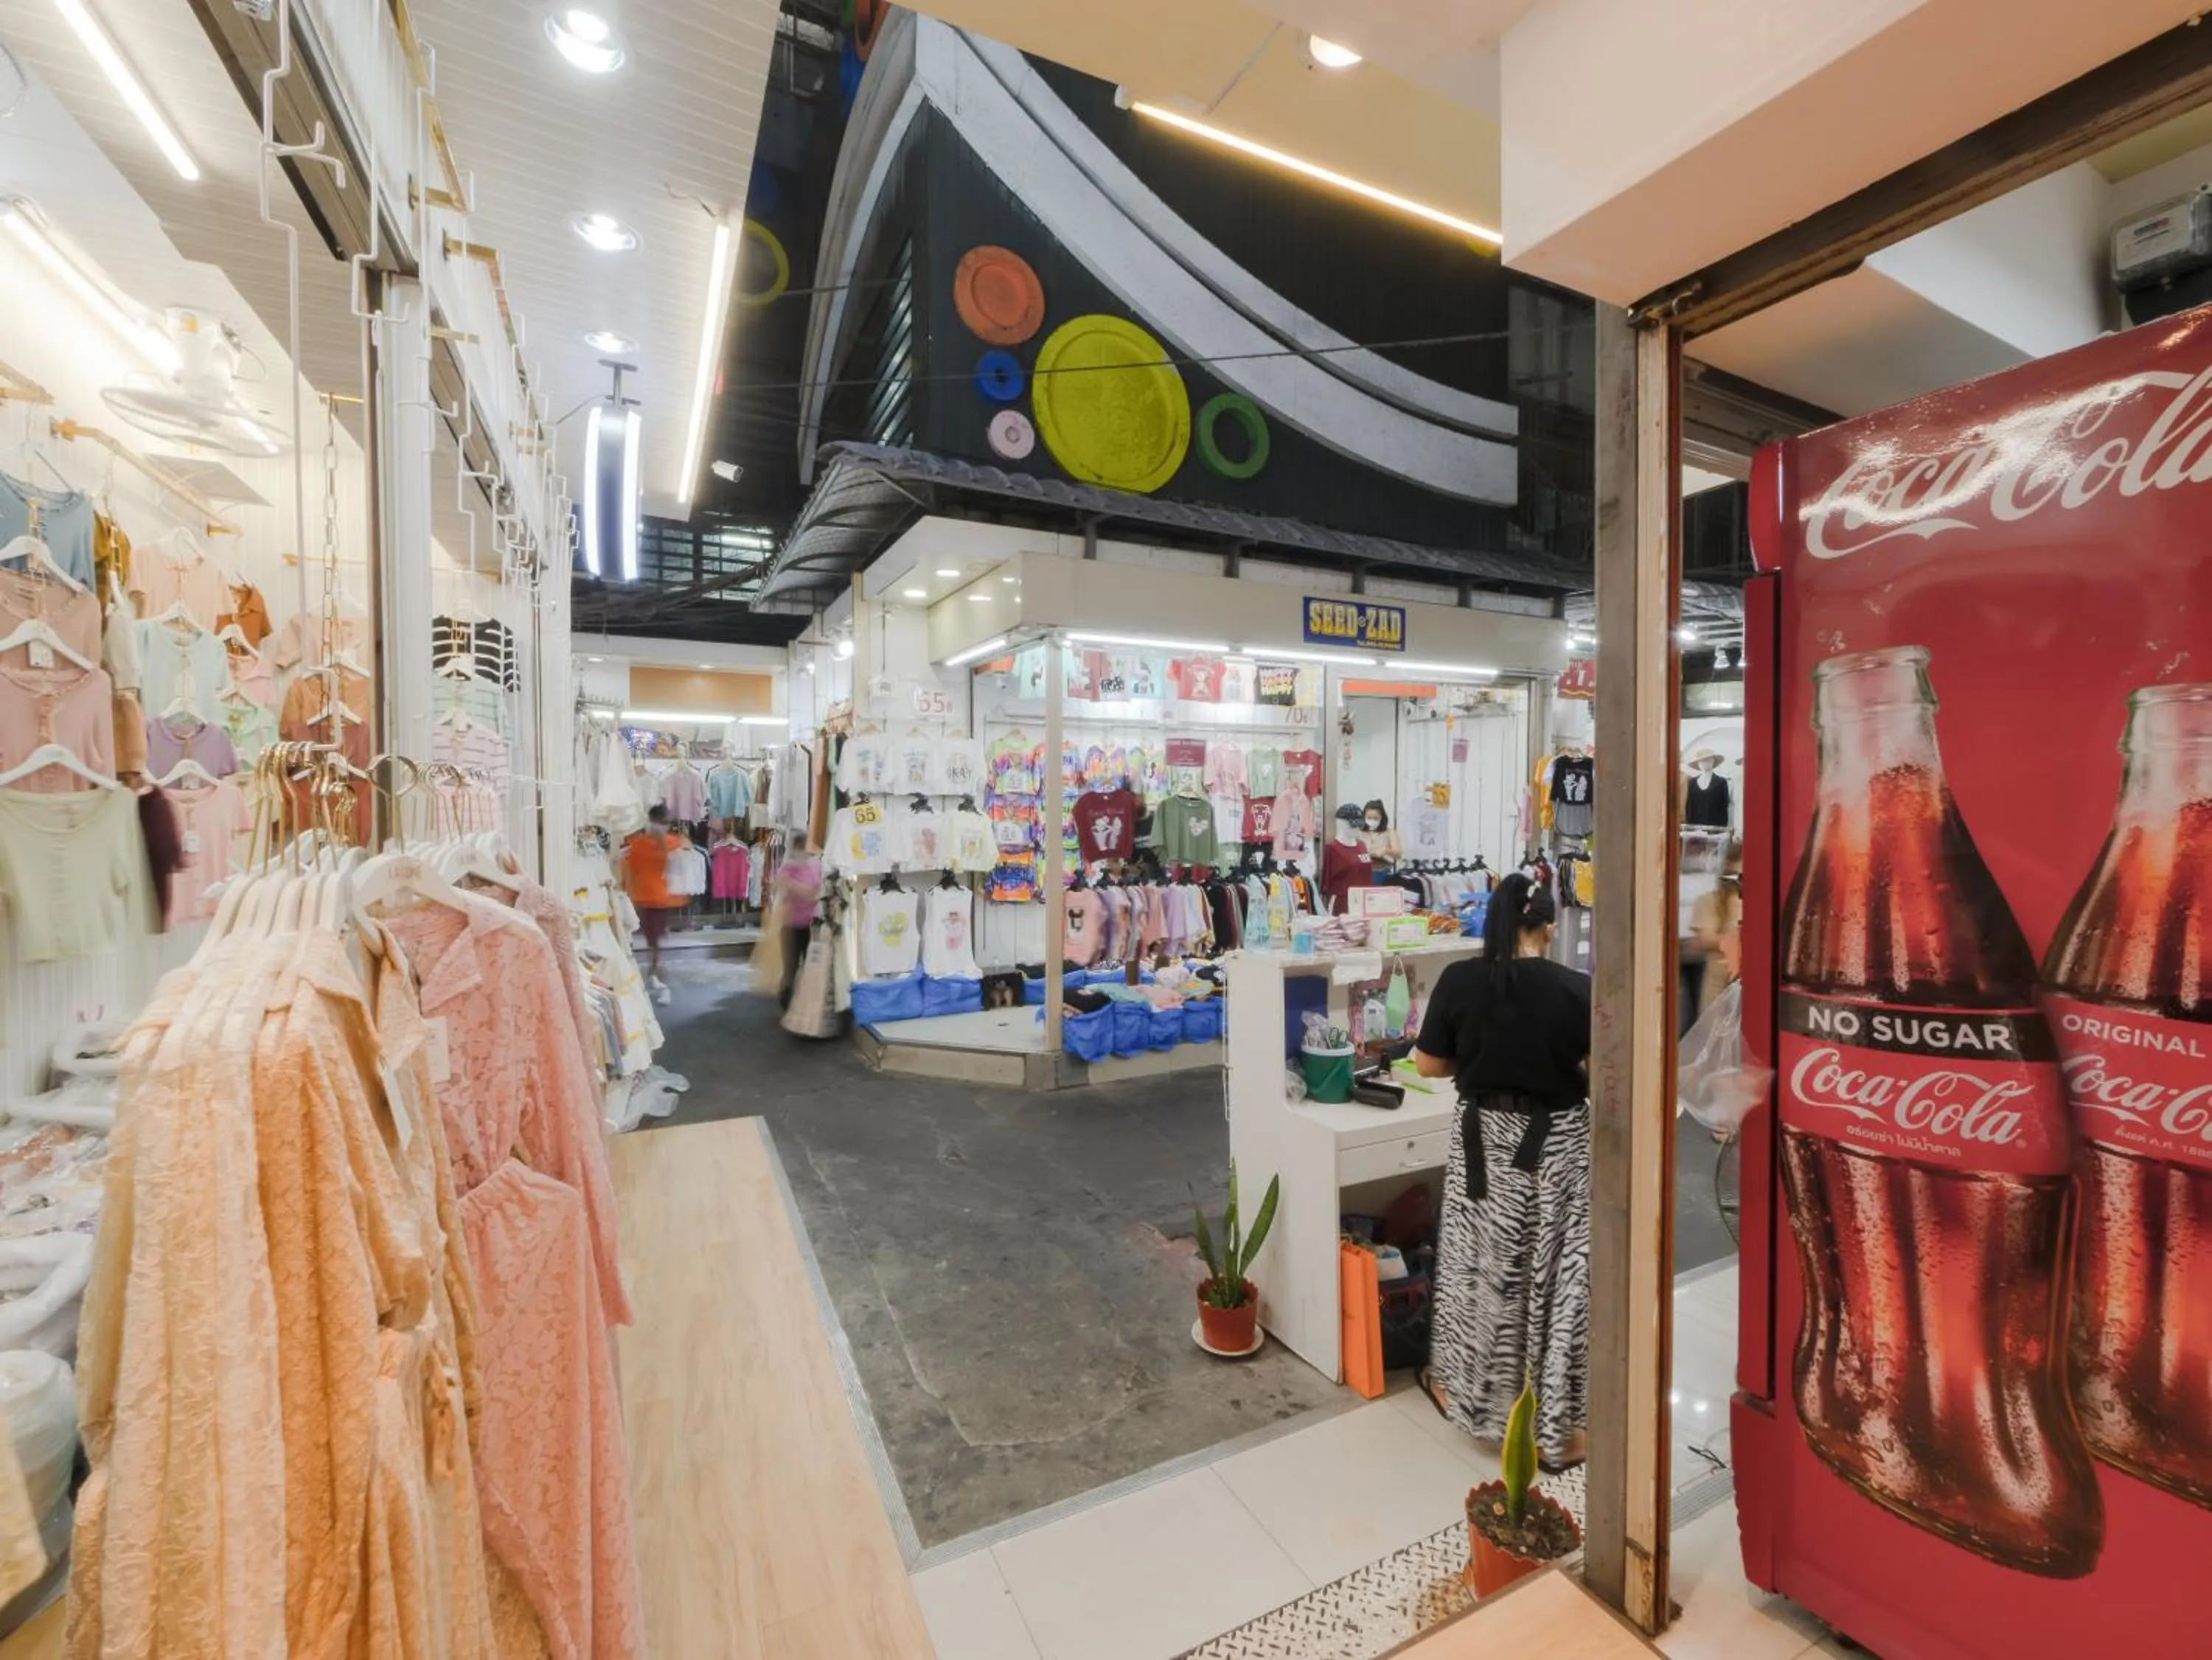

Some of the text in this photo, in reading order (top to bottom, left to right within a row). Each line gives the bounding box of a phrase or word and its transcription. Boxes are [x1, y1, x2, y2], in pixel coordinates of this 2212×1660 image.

[1805, 364, 2212, 559] CocaCola
[1365, 607, 1402, 641] ZAD
[855, 806, 876, 823] 65
[1809, 1006, 2013, 1050] NO SUGAR
[2062, 1014, 2206, 1058] ORIGINAL
[1790, 1047, 2034, 1144] Coca-Cola
[2062, 1054, 2212, 1134] Coca-C
